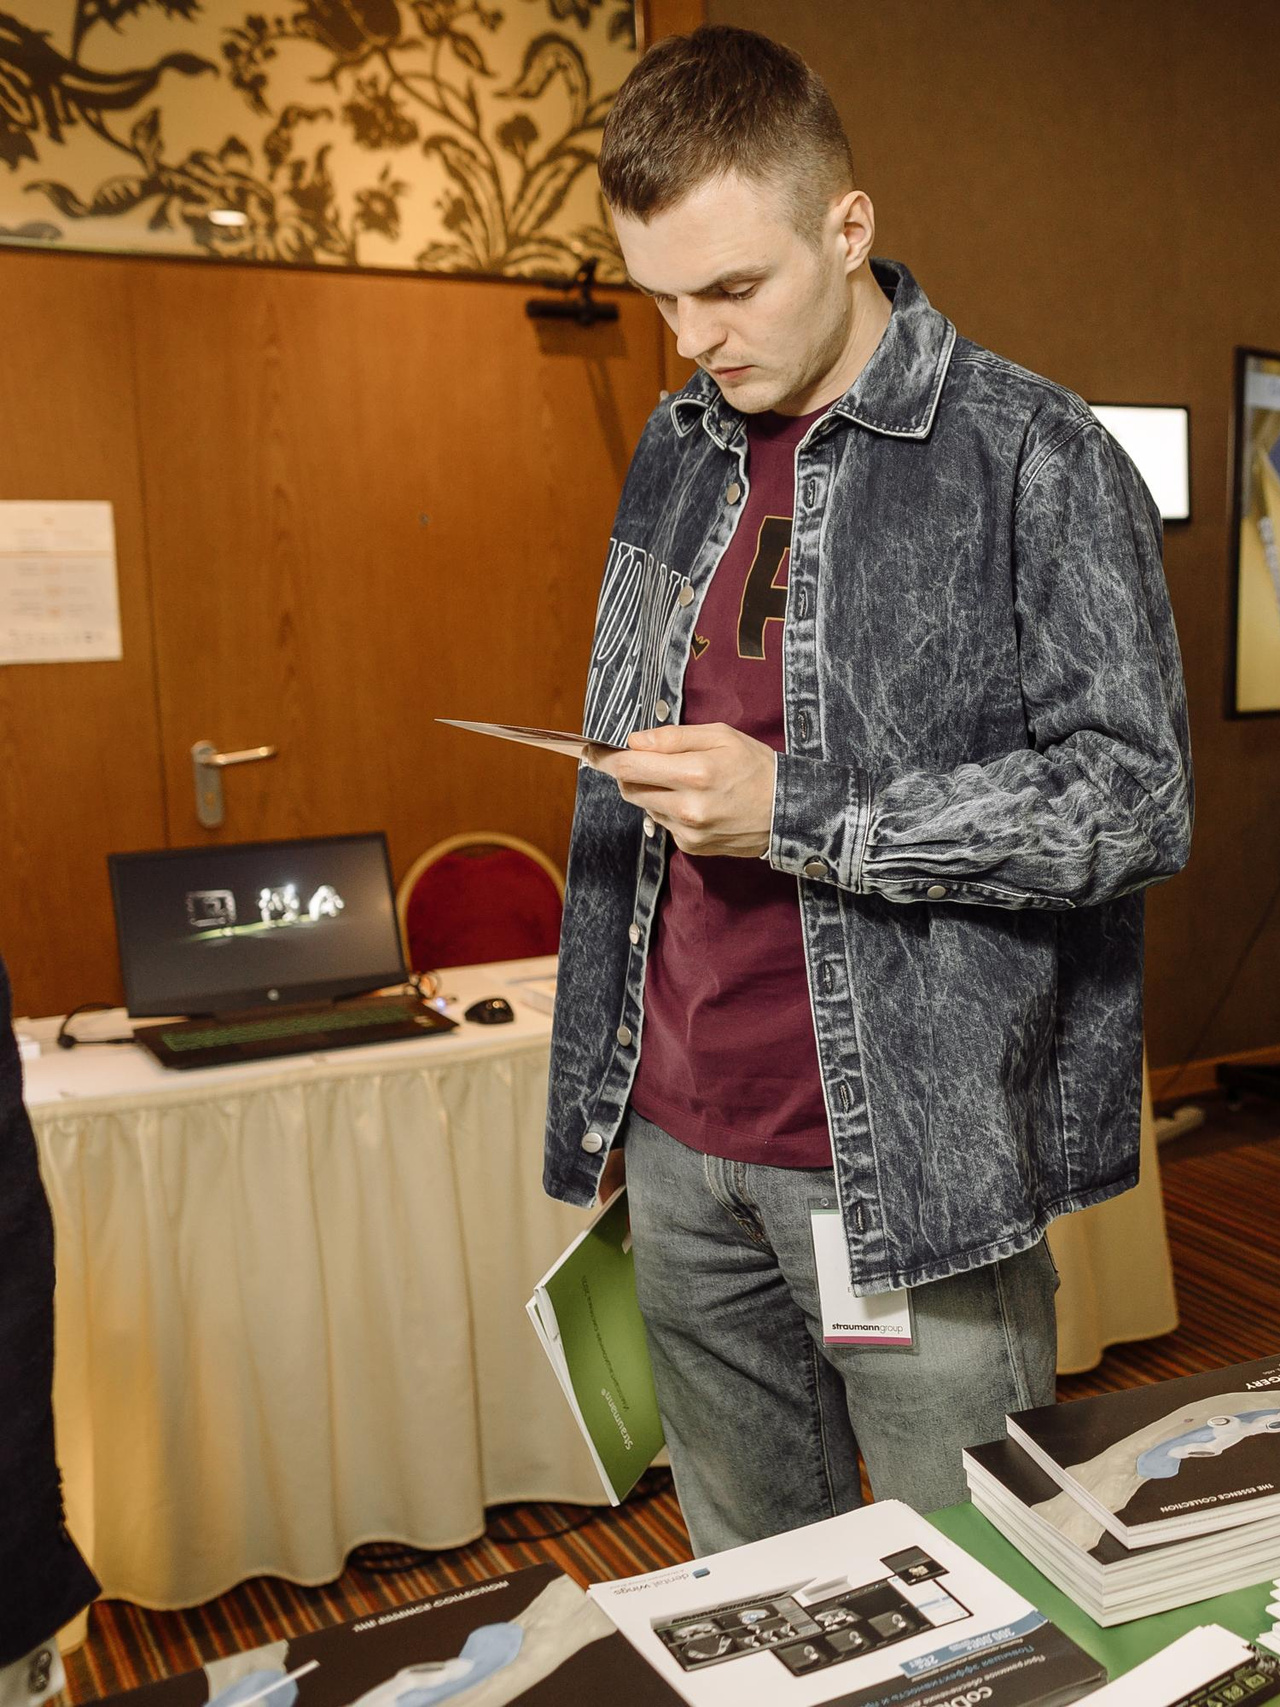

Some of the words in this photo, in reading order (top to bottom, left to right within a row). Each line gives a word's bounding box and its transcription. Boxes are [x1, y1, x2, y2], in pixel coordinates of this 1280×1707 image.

[1217, 1486, 1257, 1500] ESSENCE
[1256, 1483, 1275, 1491] THE
[1160, 1496, 1218, 1513] COLLECTION
[654, 1573, 690, 1588] dental
[613, 1583, 652, 1595] wings
[981, 1645, 1035, 1667] Повышая
[983, 1654, 1046, 1682] Программное
